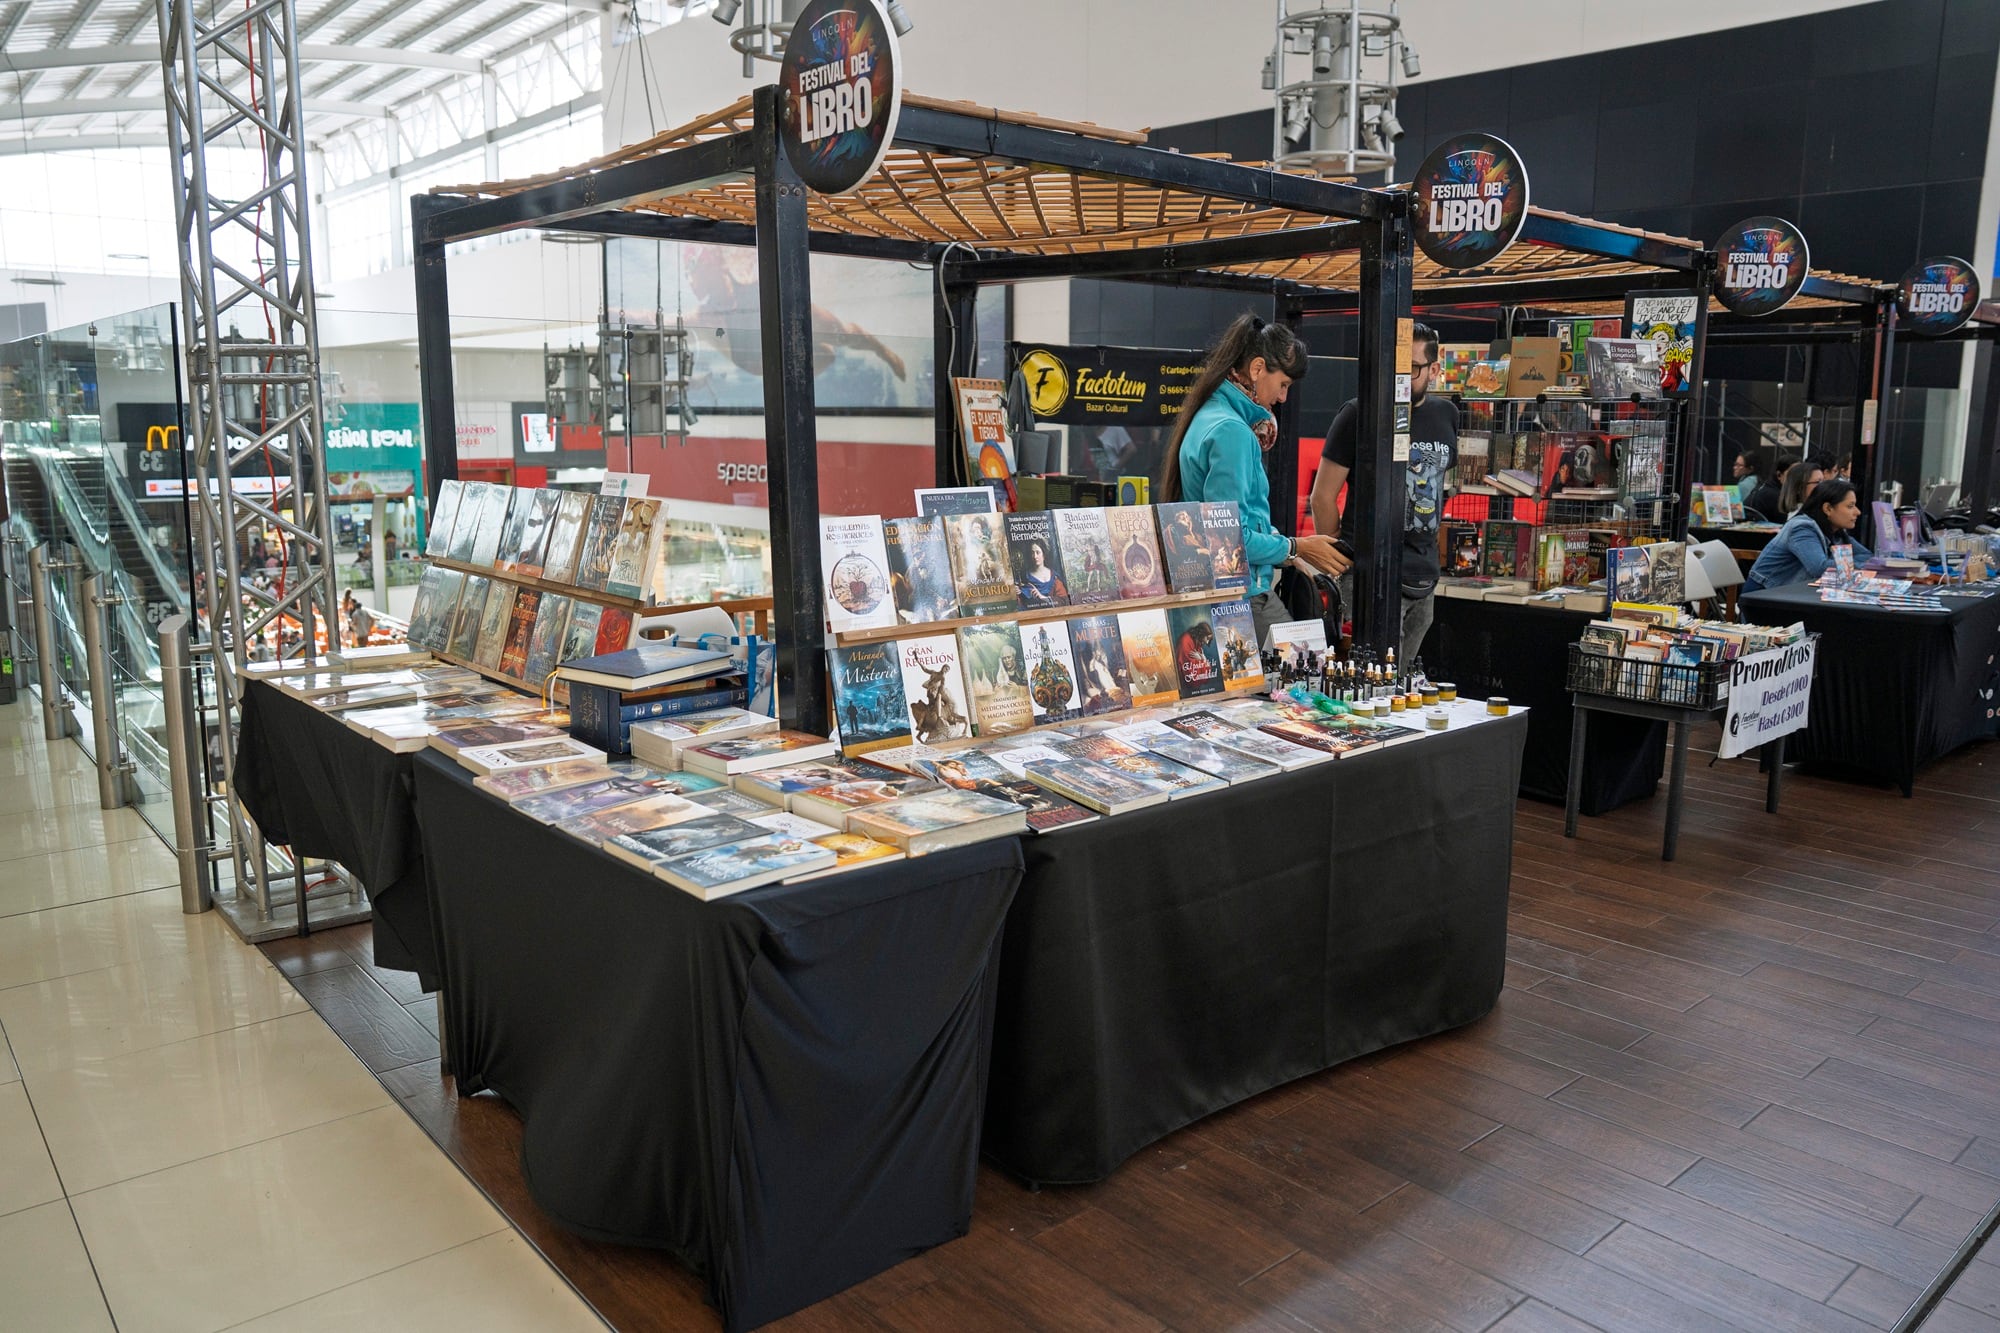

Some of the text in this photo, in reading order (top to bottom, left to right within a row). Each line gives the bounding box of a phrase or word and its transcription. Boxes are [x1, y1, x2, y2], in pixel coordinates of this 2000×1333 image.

[812, 18, 854, 42] LINCOLN
[800, 51, 870, 93] FESTIVAL DEL
[801, 77, 873, 143] LIBRO
[1448, 157, 1490, 168] LINCOLN
[1431, 182, 1503, 199] FESTIVAL DEL
[1429, 198, 1503, 232] LIBRO
[1728, 252, 1789, 263] FESTIVAL DEL
[1725, 264, 1788, 288] LIBRO
[1912, 284, 1965, 293] FESTIVAL DEL
[1657, 306, 1675, 314] AND
[1676, 305, 1692, 314] LET
[1909, 293, 1964, 312] LIBRO
[1664, 347, 1694, 364] BANG
[1074, 367, 1147, 398] Factotum
[1086, 403, 1128, 413] Bazar Cultural
[971, 411, 1003, 425] EL PLANETA
[327, 426, 369, 448] SEÑOR
[371, 429, 413, 448] BOWL
[978, 426, 999, 440] TIERRA
[1433, 441, 1449, 455] life
[1207, 509, 1232, 518] MAGIA
[1010, 521, 1049, 533] Astrología
[1114, 519, 1150, 533] FUEGO
[1203, 517, 1240, 529] PRÁCTICA
[1011, 531, 1051, 542] Hermética
[963, 584, 1011, 599] ACUARIO
[1211, 603, 1250, 617] OCULTISMO
[906, 645, 933, 657] GRAN
[905, 653, 955, 668] REBELIÓN
[841, 667, 899, 685] Misterio
